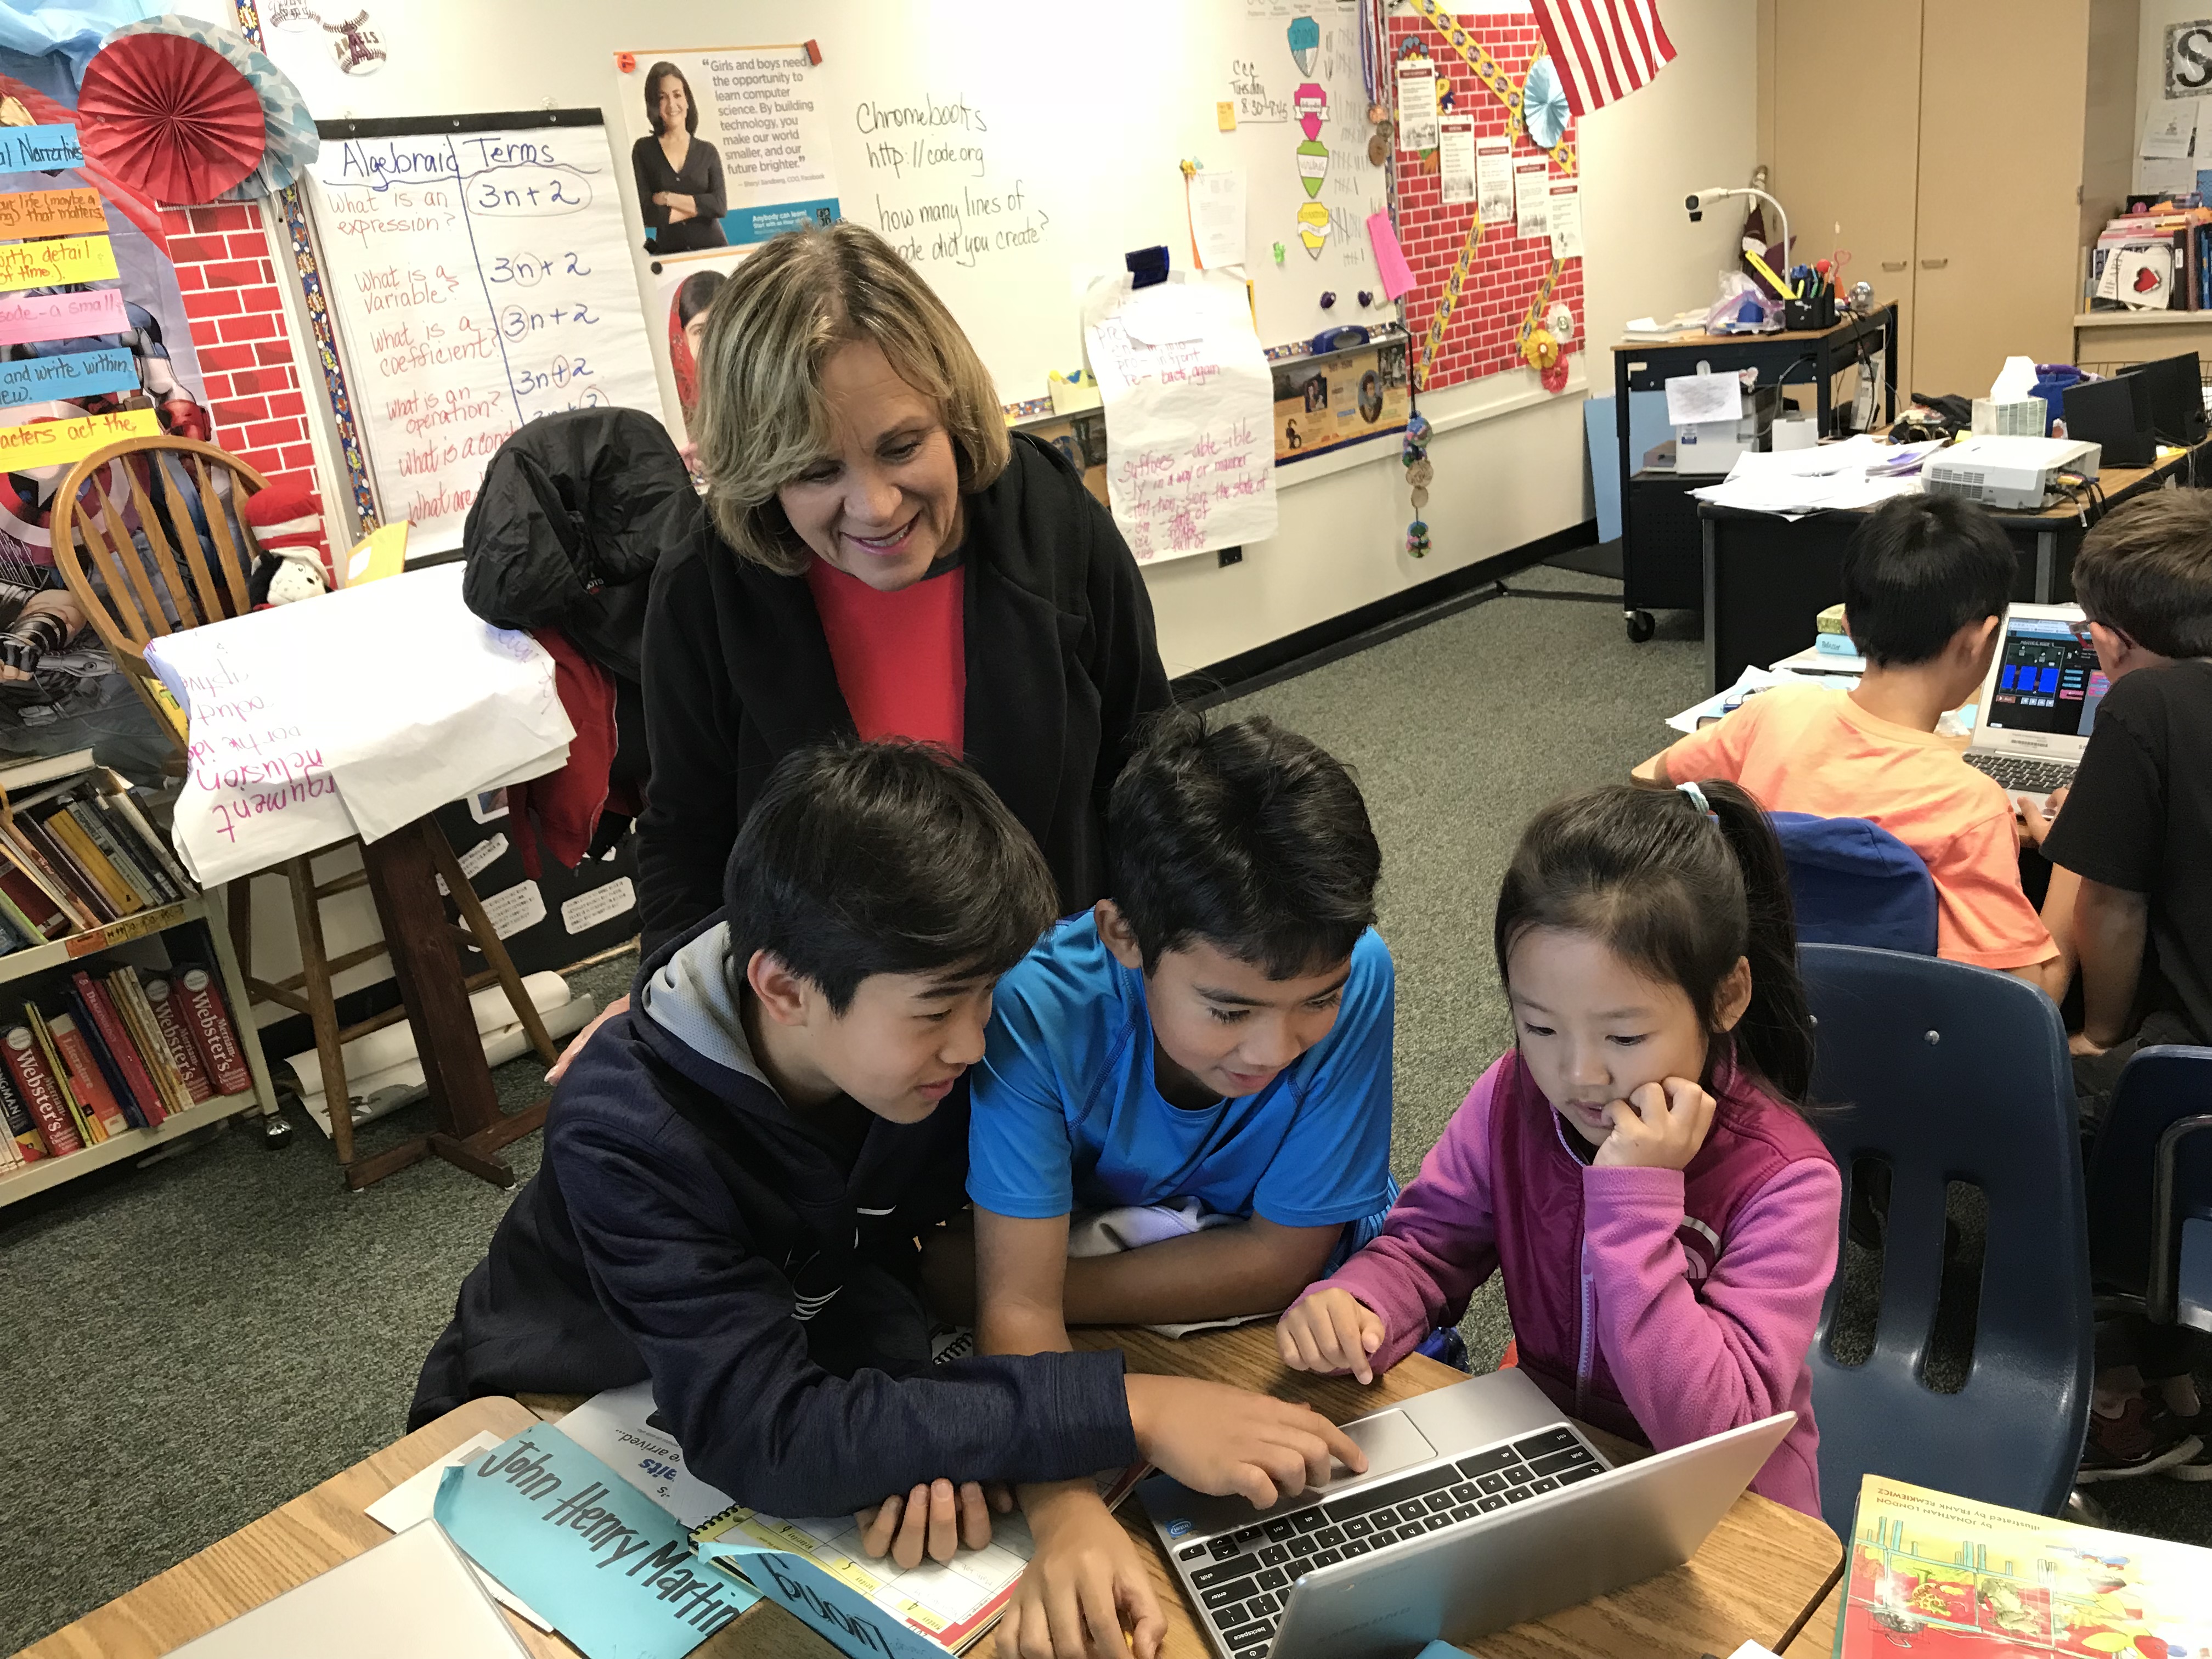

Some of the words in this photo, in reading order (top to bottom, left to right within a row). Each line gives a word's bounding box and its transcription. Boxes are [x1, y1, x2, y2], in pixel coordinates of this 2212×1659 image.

[736, 59, 755, 70] and
[757, 58, 781, 71] boys
[783, 57, 807, 67] need
[713, 76, 730, 87] the
[732, 72, 791, 87] opportunity
[792, 72, 803, 82] to
[715, 91, 741, 101] learn
[743, 88, 790, 101] computer
[718, 104, 757, 116] science.
[759, 103, 772, 115] By
[775, 100, 814, 112] building
[856, 92, 988, 134] Chromebooks
[720, 117, 778, 131] technology,
[780, 116, 798, 128] you
[723, 134, 751, 146] make
[752, 134, 769, 143] our
[771, 129, 800, 142] world
[462, 137, 555, 167] Terms
[725, 148, 763, 161] smaller,
[765, 145, 783, 156] and
[785, 145, 802, 155] our
[866, 138, 985, 179] http://code.org
[727, 163, 758, 175] future
[19, 193, 43, 209] life
[88, 195, 96, 206] a
[328, 189, 380, 213] What
[394, 189, 411, 207] is
[425, 190, 448, 208] an
[876, 193, 915, 233] how
[919, 202, 963, 240] many
[964, 185, 1002, 217] lines
[1007, 179, 1025, 211] of
[26, 206, 55, 222] that
[337, 212, 456, 249] expression?
[932, 232, 960, 261] did
[956, 235, 990, 268] you
[995, 209, 1050, 249] create?
[42, 239, 90, 263] detail
[354, 267, 396, 294] What
[408, 262, 427, 281] is
[436, 264, 456, 280] a
[69, 293, 114, 314] small
[364, 275, 460, 314] variable?
[370, 325, 414, 354] What
[426, 321, 445, 340] is
[459, 316, 478, 332] a
[380, 328, 500, 377] coefficient?
[4, 364, 32, 385] and
[34, 358, 81, 381] write
[83, 353, 127, 375] within
[386, 390, 419, 421] What
[424, 389, 439, 409] is
[446, 386, 470, 403] an
[406, 390, 505, 435] operation?
[68, 416, 97, 440] act
[103, 412, 135, 433] the
[398, 439, 438, 477] What
[442, 439, 458, 463] is
[462, 438, 476, 459] a
[408, 481, 451, 522] What
[154, 998, 195, 1093] Webster's
[191, 990, 231, 1085] Webster's
[16, 1048, 63, 1147] Webster's
[1876, 1497, 1920, 1513] LONDON
[1877, 1487, 1936, 1507] REMKIEWICZ
[1923, 1508, 1977, 1526] JONATHAN
[1939, 1503, 1971, 1515] FRANK
[1974, 1511, 1986, 1519] by
[1304, 1515, 1314, 1523] alt
[1980, 1521, 1993, 1530] by
[1989, 1514, 2041, 1531] illustrated
[477, 1440, 563, 1502] John
[541, 1481, 651, 1570] Henry
[625, 1539, 740, 1637] Martin
[1273, 1525, 1284, 1533] ctrl
[855, 1576, 876, 1593] Tuesday
[1001, 1570, 1025, 1590] athematics
[1199, 1572, 1214, 1582] shift
[1210, 1590, 1228, 1600] enter
[907, 1600, 919, 1611] 4
[970, 1597, 991, 1614] Language
[922, 1616, 944, 1631] Monday
[1233, 1625, 1266, 1642] backspace
